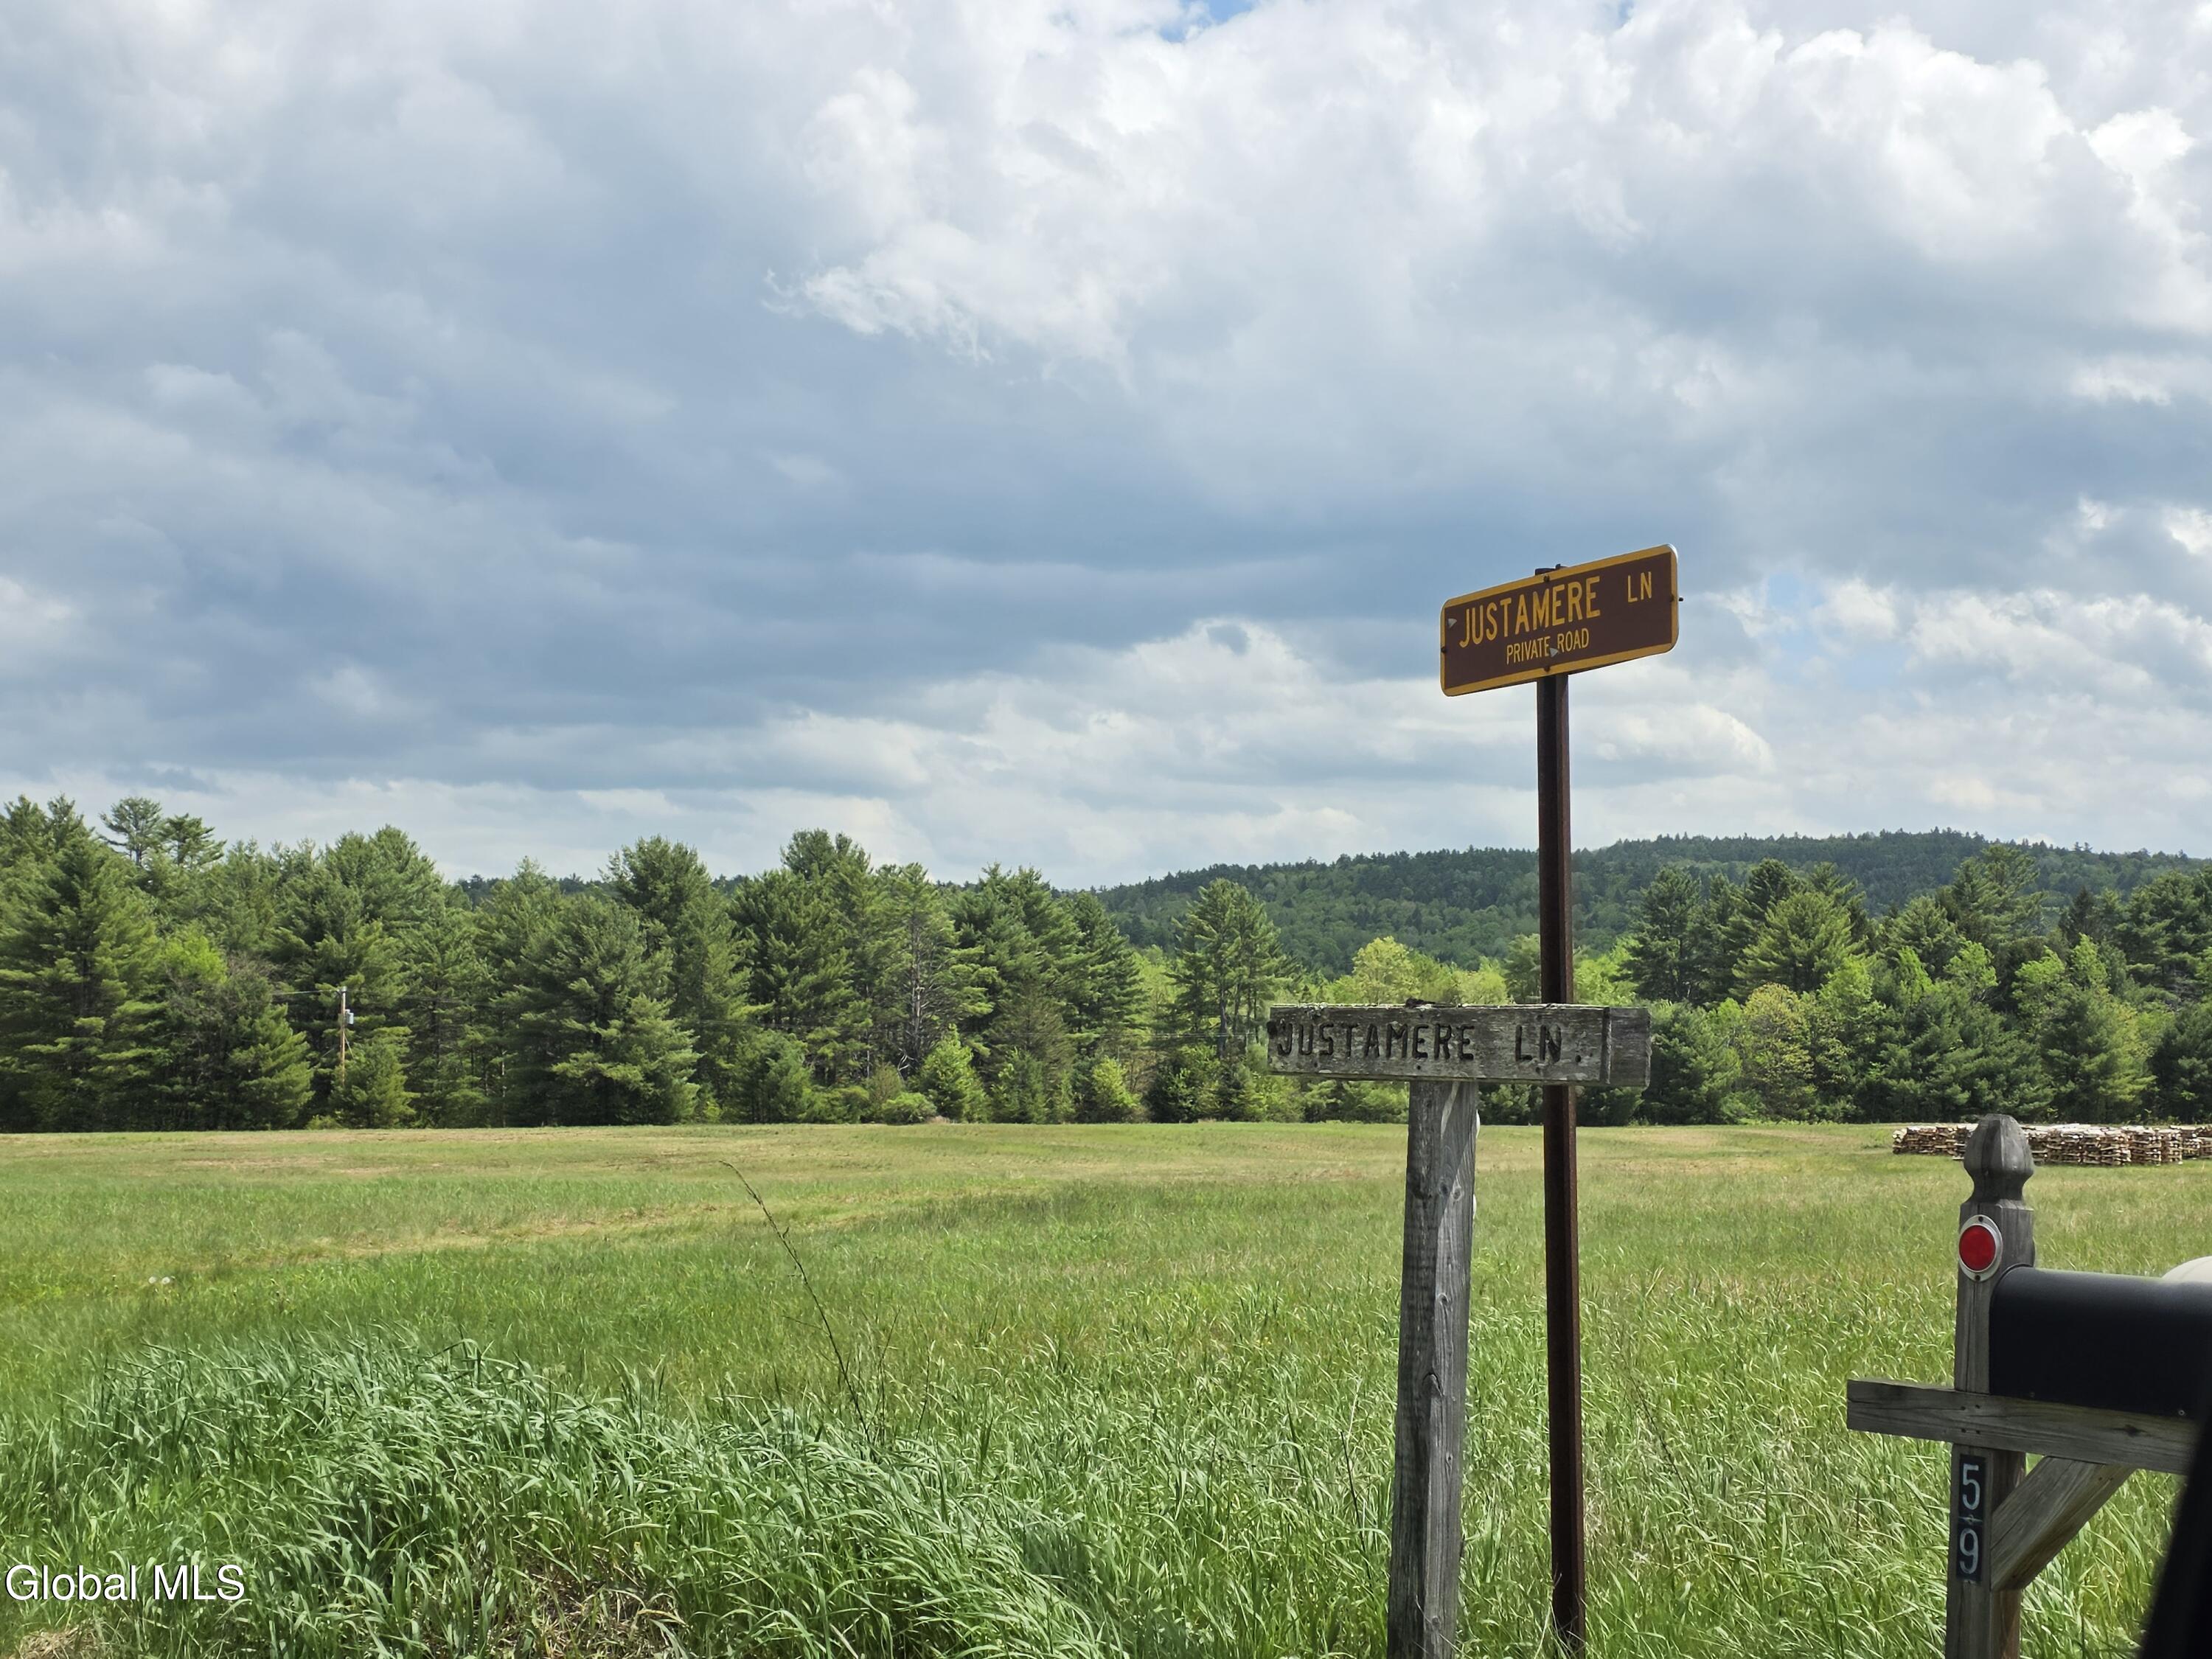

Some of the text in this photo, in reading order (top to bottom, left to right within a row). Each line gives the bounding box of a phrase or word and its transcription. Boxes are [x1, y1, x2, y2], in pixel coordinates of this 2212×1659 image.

[1459, 571, 1652, 648] JUSTAMERE LN
[1506, 627, 1590, 664] PRIVATE ROAD
[1277, 1023, 1474, 1060] JUSTAMERE
